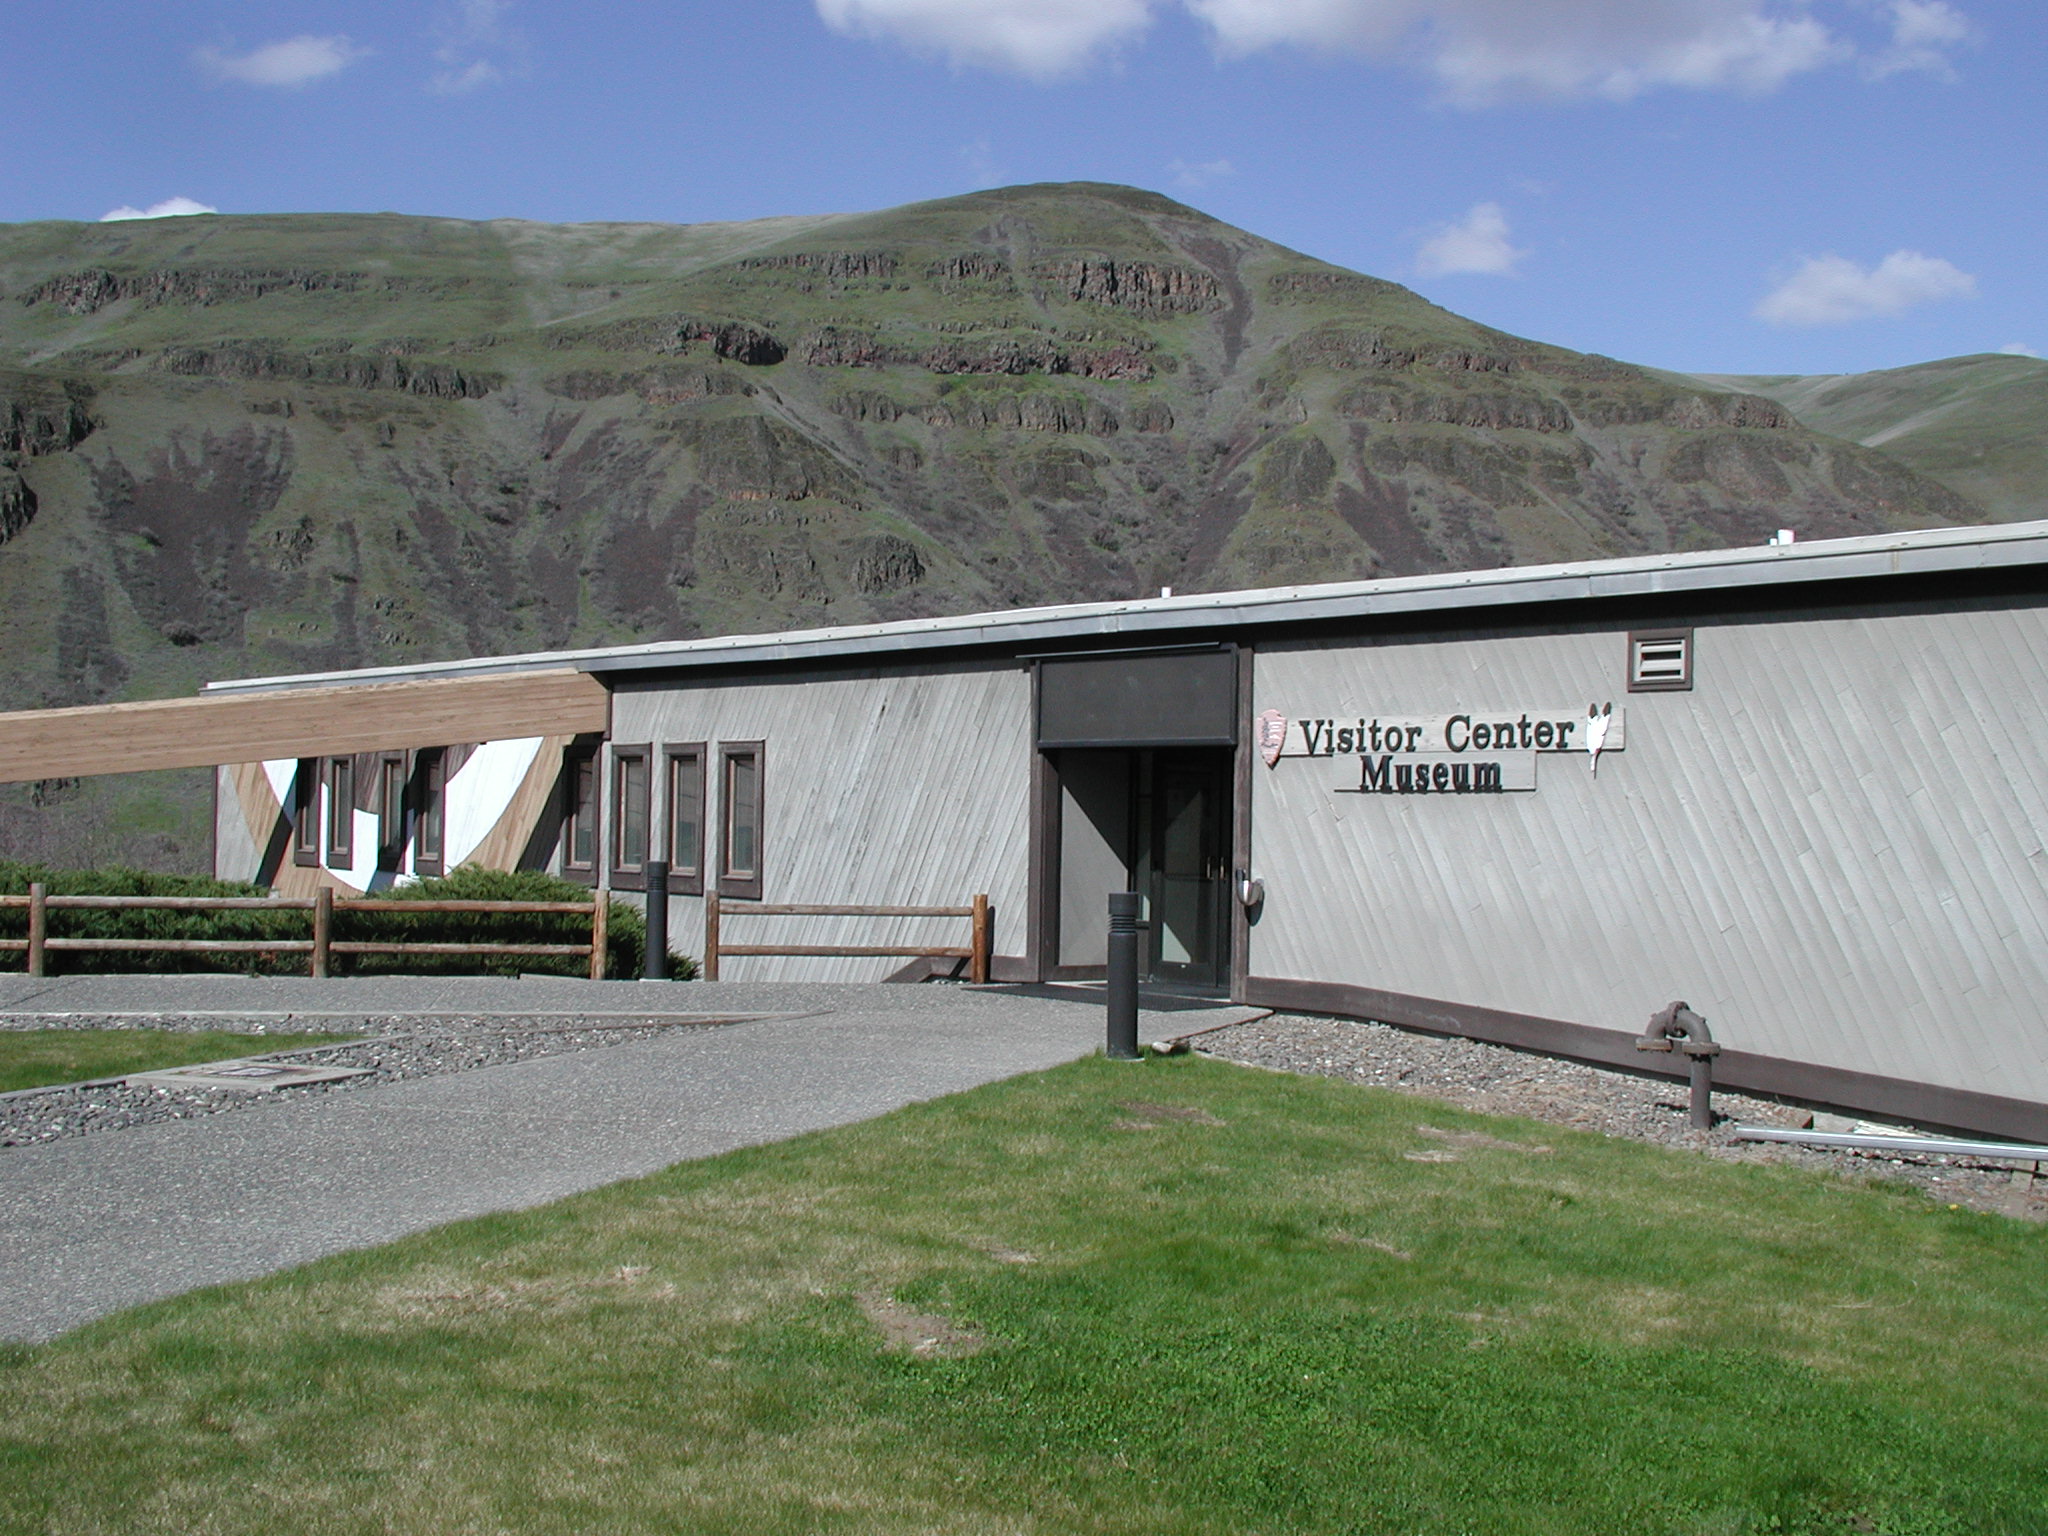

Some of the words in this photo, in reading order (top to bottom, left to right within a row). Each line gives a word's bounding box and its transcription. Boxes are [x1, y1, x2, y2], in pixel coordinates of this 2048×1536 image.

[1300, 718, 1422, 754] Visitor
[1446, 713, 1574, 753] Center
[1360, 755, 1503, 794] Museum
